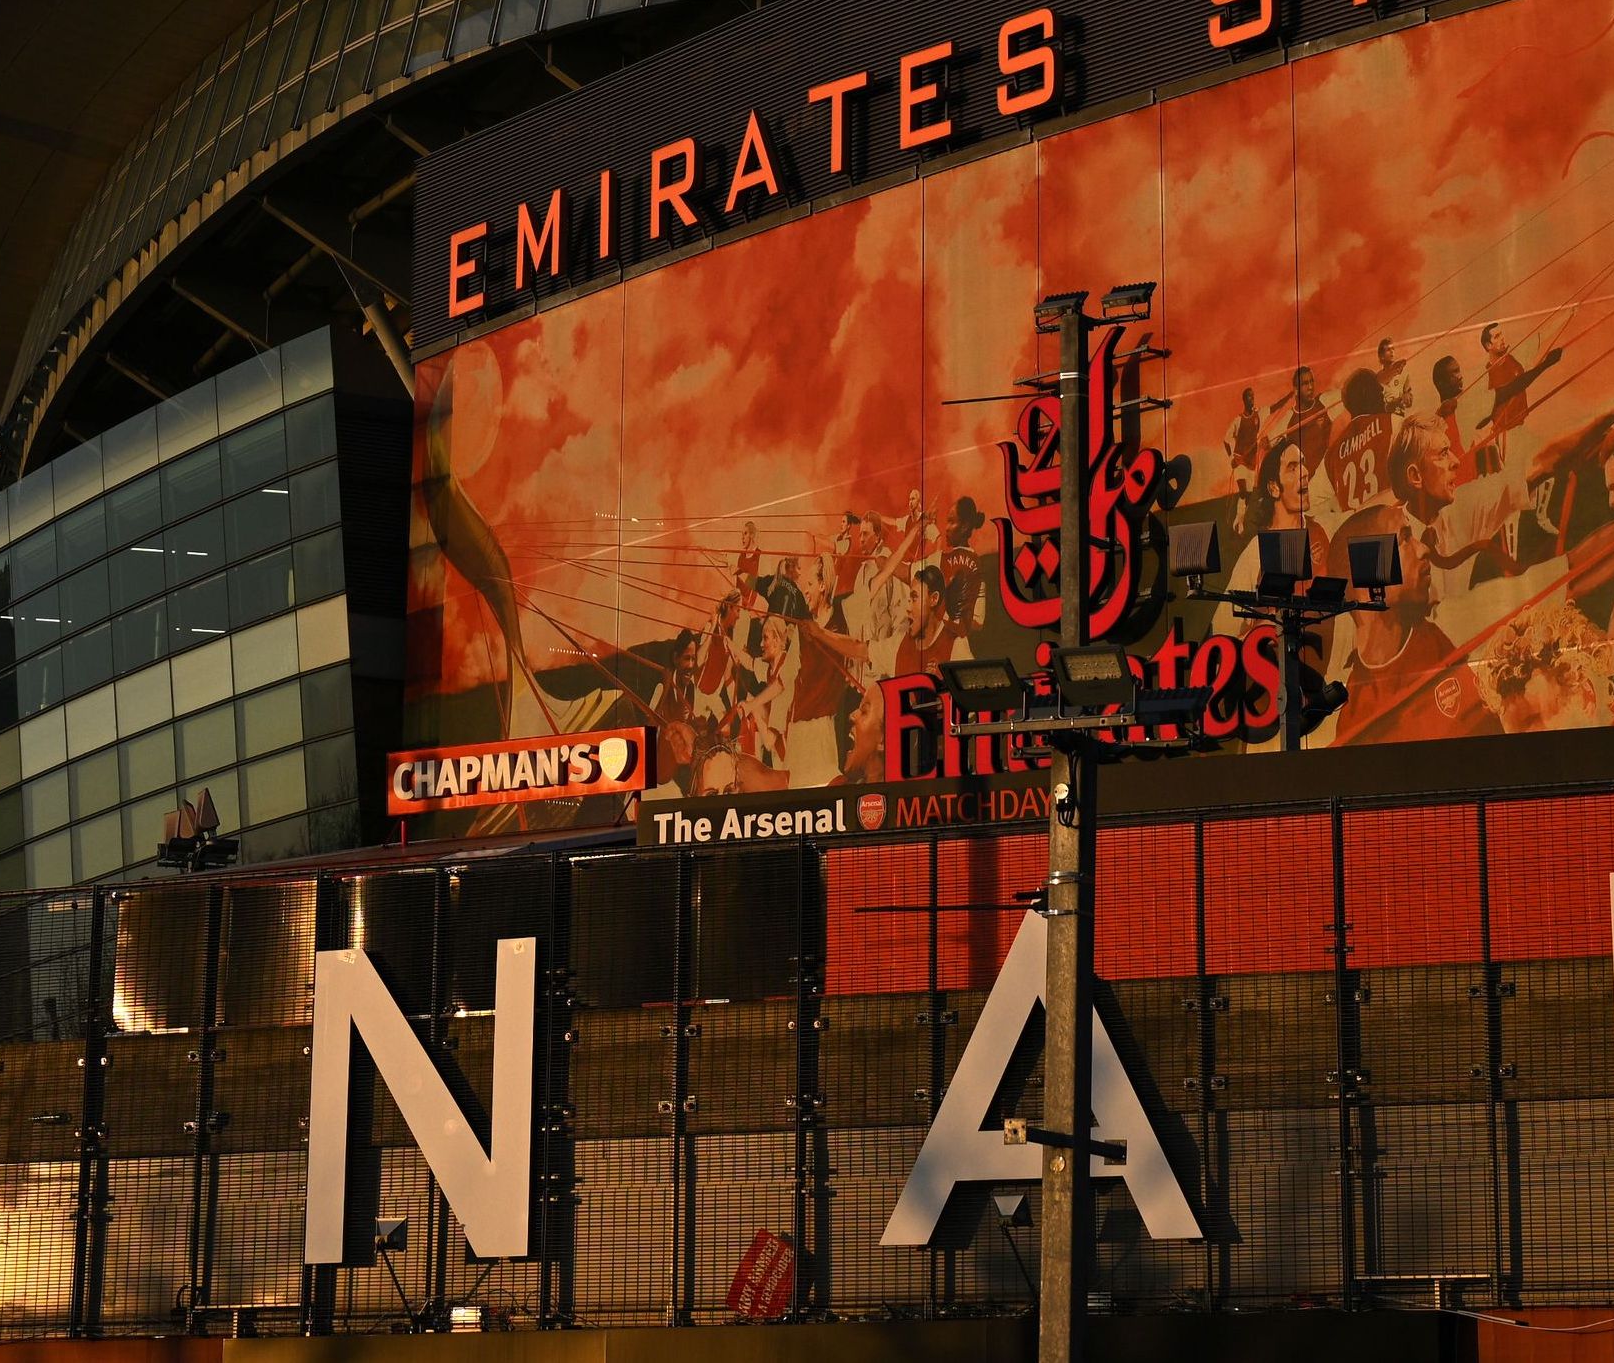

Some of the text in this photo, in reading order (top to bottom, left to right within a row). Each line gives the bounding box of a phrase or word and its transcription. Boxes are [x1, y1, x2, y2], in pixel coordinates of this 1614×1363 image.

[446, 6, 1061, 320] EMIRATES
[1338, 417, 1383, 460] CAMPBELL
[1342, 448, 1379, 509] 23
[877, 623, 1283, 784] Emiates
[392, 743, 593, 801] CHAPMAN'S
[652, 798, 847, 845] The Arsenal
[896, 786, 1051, 829] MATCHDAY
